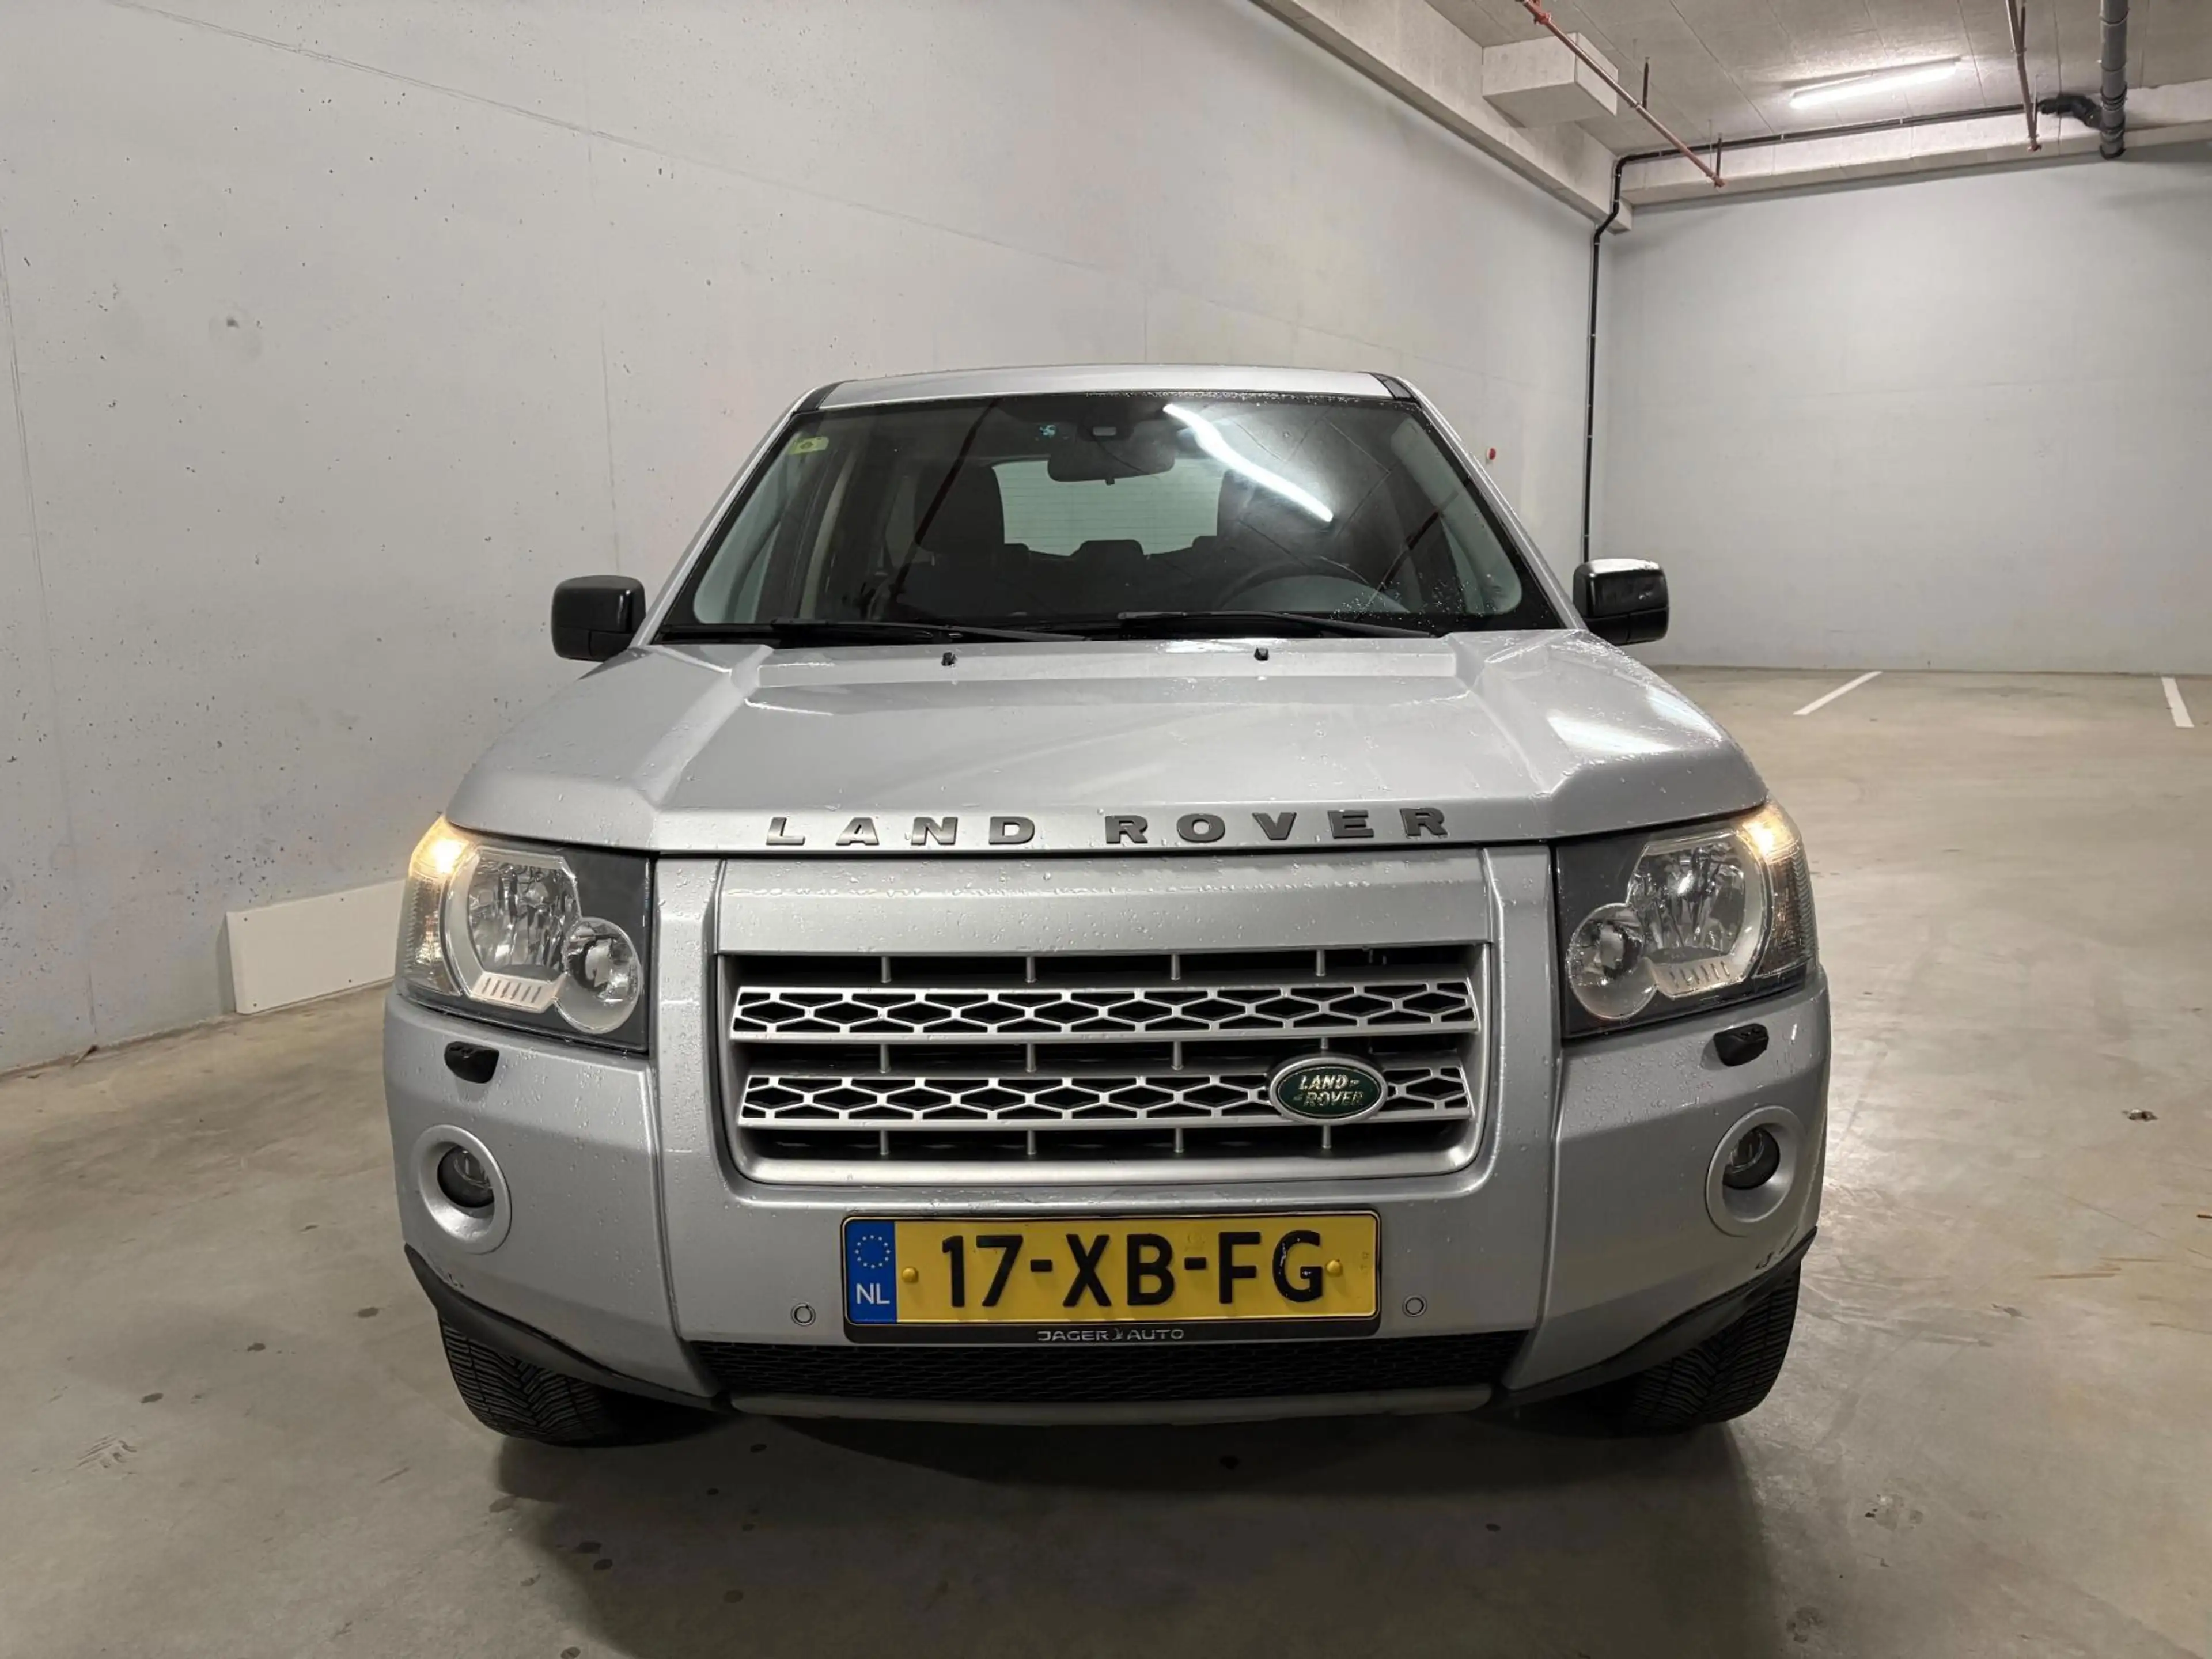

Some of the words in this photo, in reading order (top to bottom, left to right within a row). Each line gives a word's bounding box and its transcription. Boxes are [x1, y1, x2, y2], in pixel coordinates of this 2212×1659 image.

[766, 816, 1036, 846] LAND
[1105, 807, 1448, 844] ROVER
[1298, 1075, 1349, 1090] LAND
[1303, 1091, 1364, 1107] ROVER
[941, 1230, 1324, 1308] 17-XB-FG
[856, 1283, 890, 1304] NL
[1037, 1330, 1109, 1342] JAGER
[1127, 1328, 1184, 1340] AUTO
